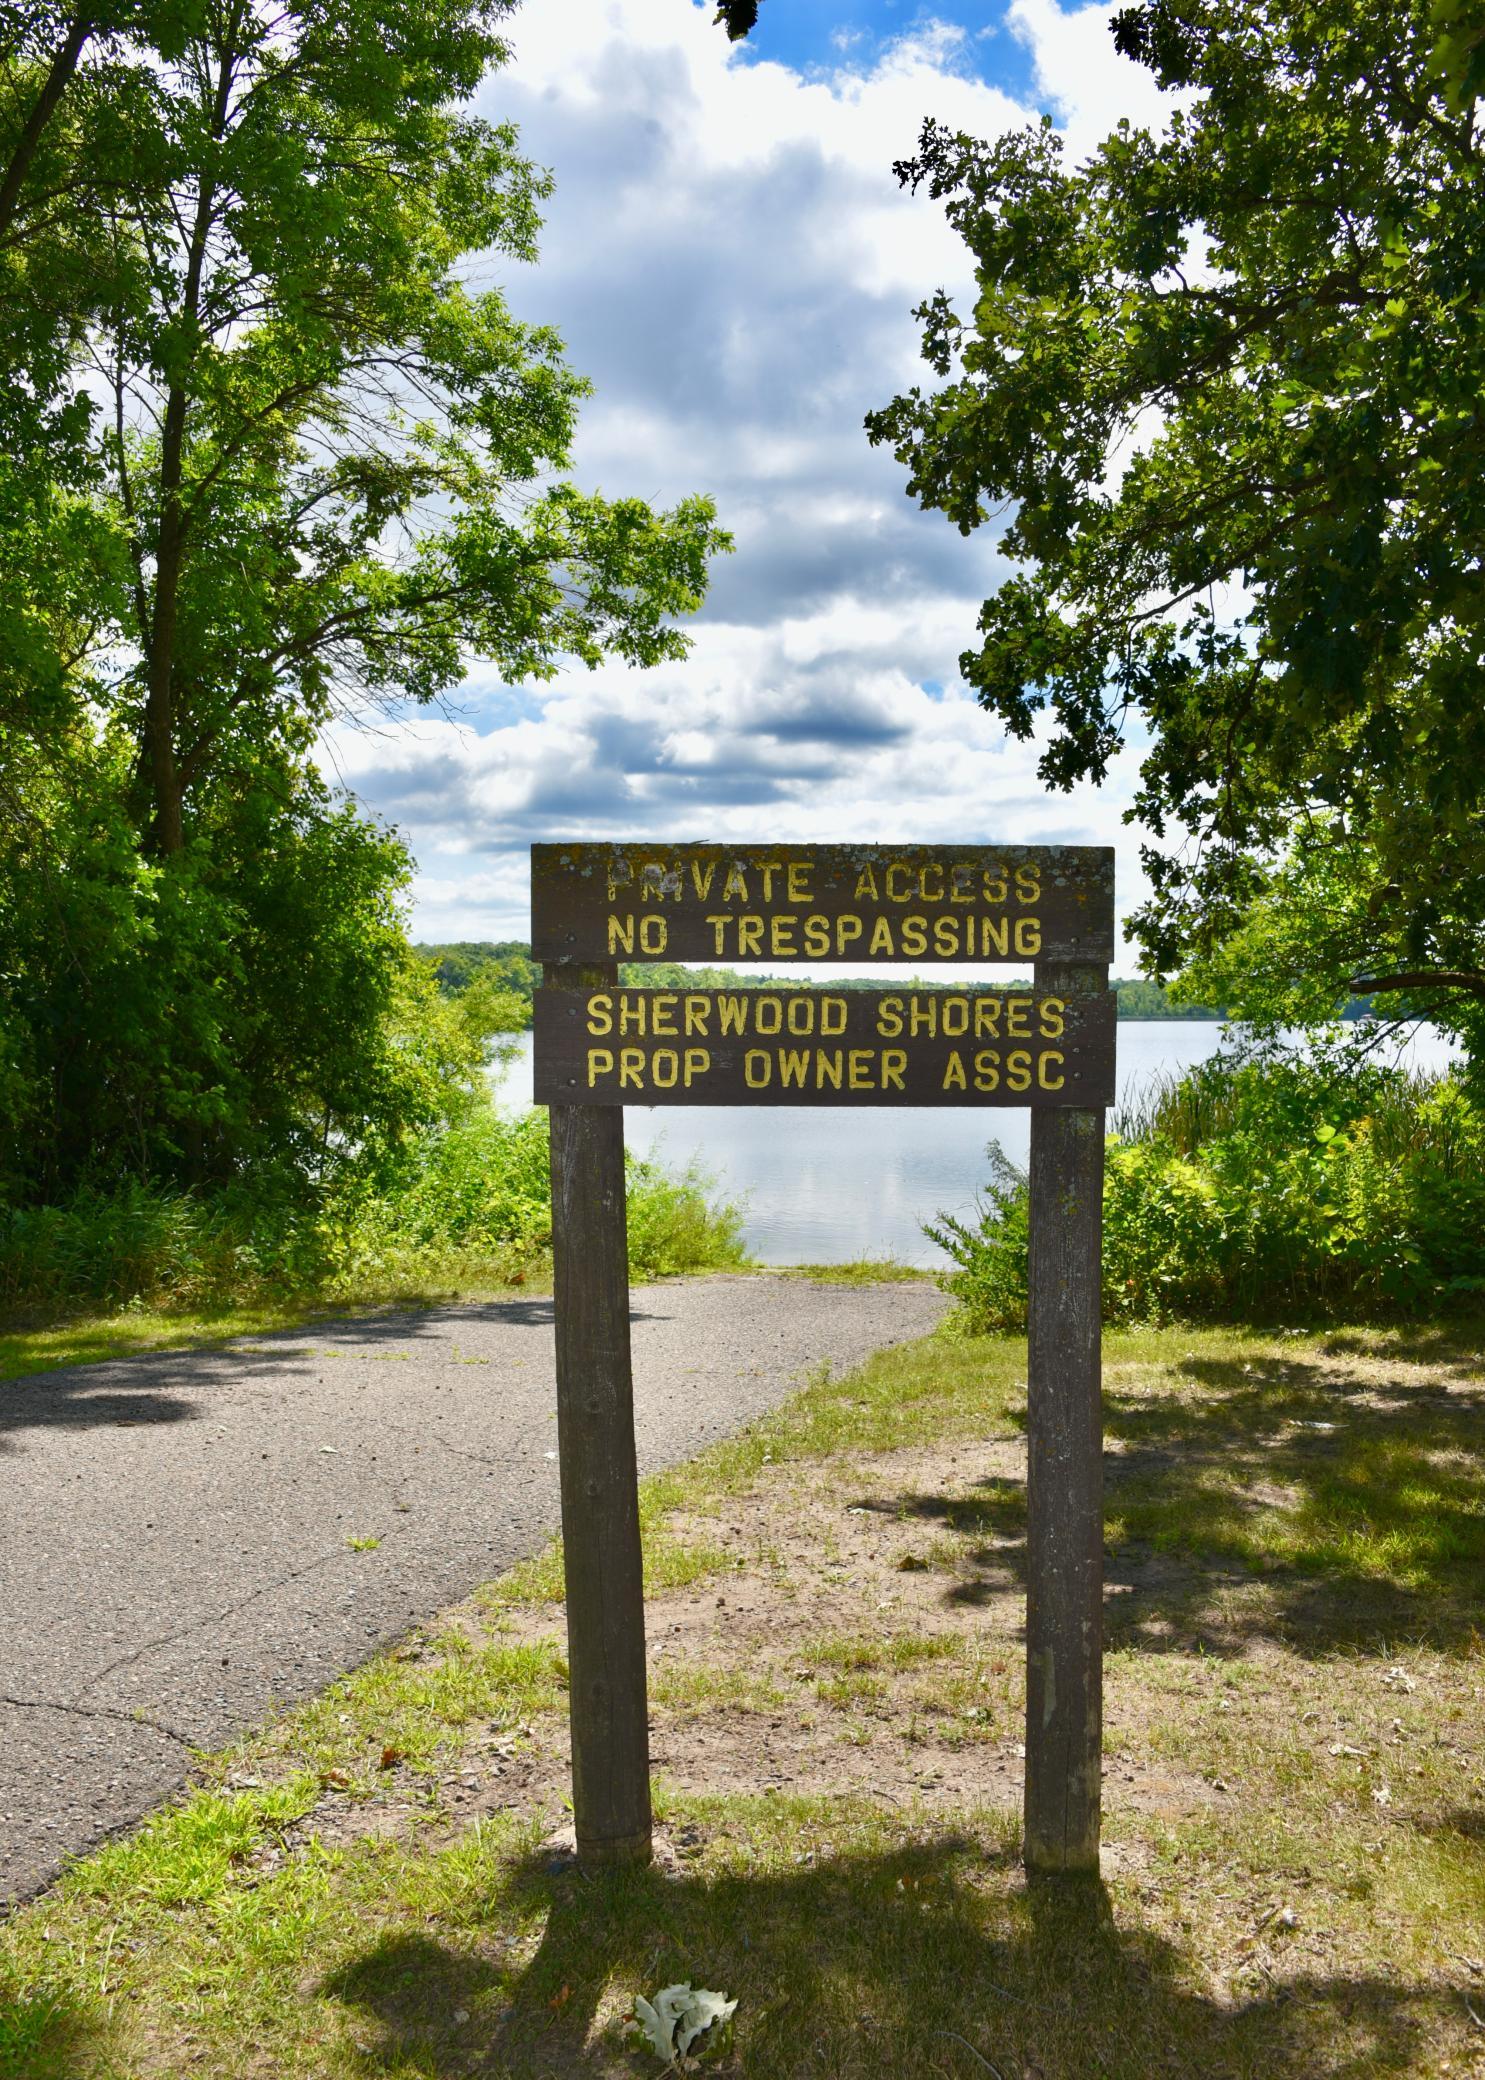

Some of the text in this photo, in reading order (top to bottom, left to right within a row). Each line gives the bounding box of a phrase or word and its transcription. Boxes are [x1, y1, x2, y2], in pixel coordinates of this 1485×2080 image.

[607, 860, 1041, 903] PRIVATE ACCESS
[607, 914, 1042, 957] NO TRESPASSING
[586, 994, 1065, 1039] SHERWOOD SHORES
[587, 1047, 1065, 1091] PROP OWNER ASSC
